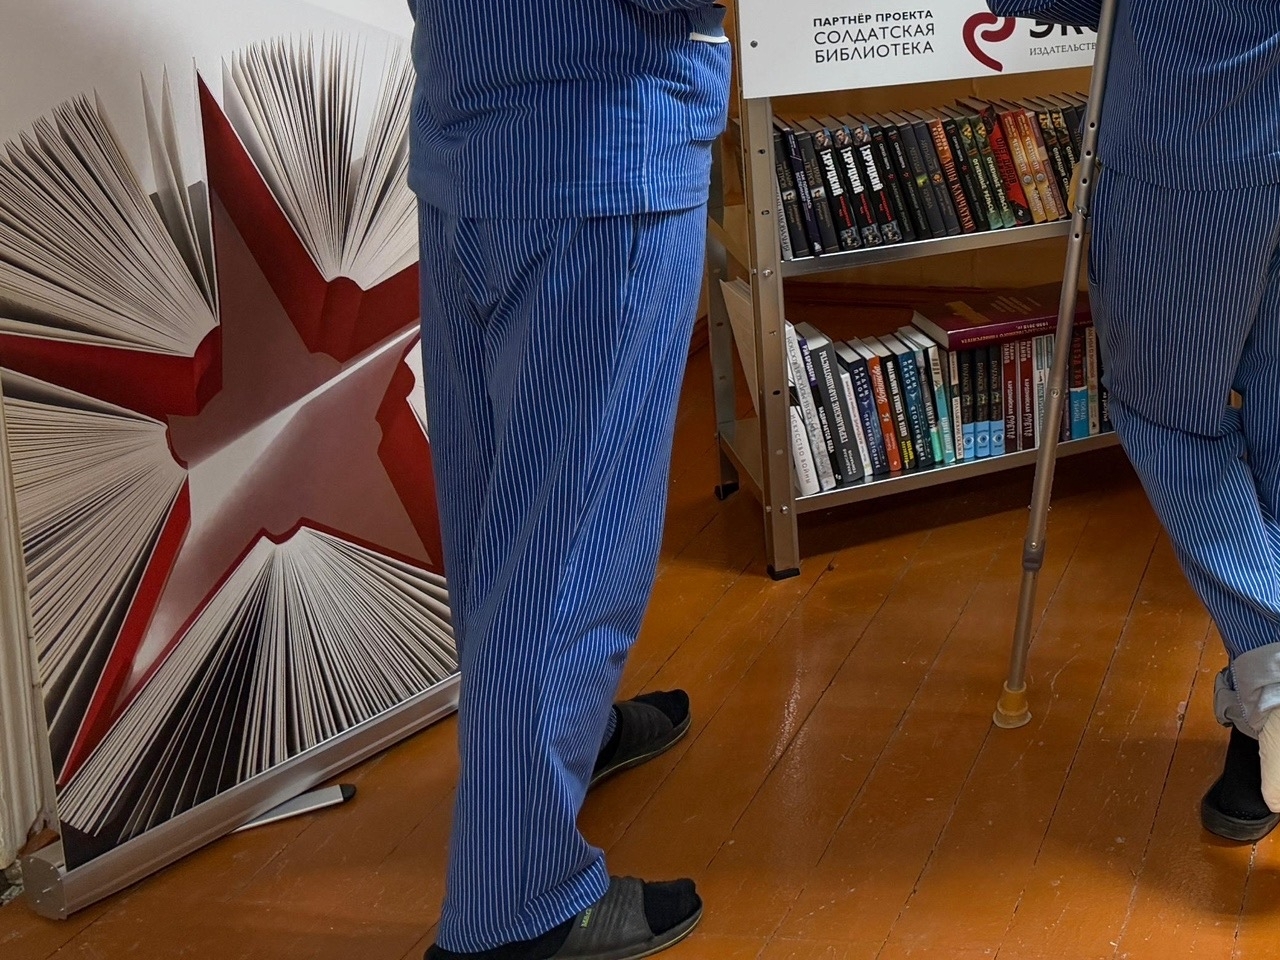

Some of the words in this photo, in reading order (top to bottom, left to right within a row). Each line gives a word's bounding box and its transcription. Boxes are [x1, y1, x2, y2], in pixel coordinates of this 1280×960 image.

[813, 13, 872, 27] ПАРТНЁР
[875, 10, 933, 22] ПРОЕКТА
[814, 23, 935, 45] СОЛДАТСКАЯ
[815, 41, 934, 63] БИБЛИОТЕКА
[1029, 42, 1096, 56] ИЗДАТЕЛЬСТВ
[822, 153, 844, 197] ХРУЦКИЙ
[842, 151, 864, 194] ХРУЦКИЙ
[861, 149, 885, 192] ХРУЦКИЙ
[941, 153, 958, 182] ТАЙНЫ
[951, 183, 974, 230] КАМЧАТКИ
[972, 158, 987, 189] ОГНЕННЫЕ
[983, 190, 995, 214] РЕЛЬСЫ
[986, 156, 1001, 188] ОГНЕННЫЕ
[997, 188, 1009, 212] РЕЛЬСЫ
[819, 351, 838, 401] ПАРАШЮТИСТЫ
[832, 401, 848, 443] ГЕРМАНСКИЕ
[898, 421, 907, 436] ОХОТА
